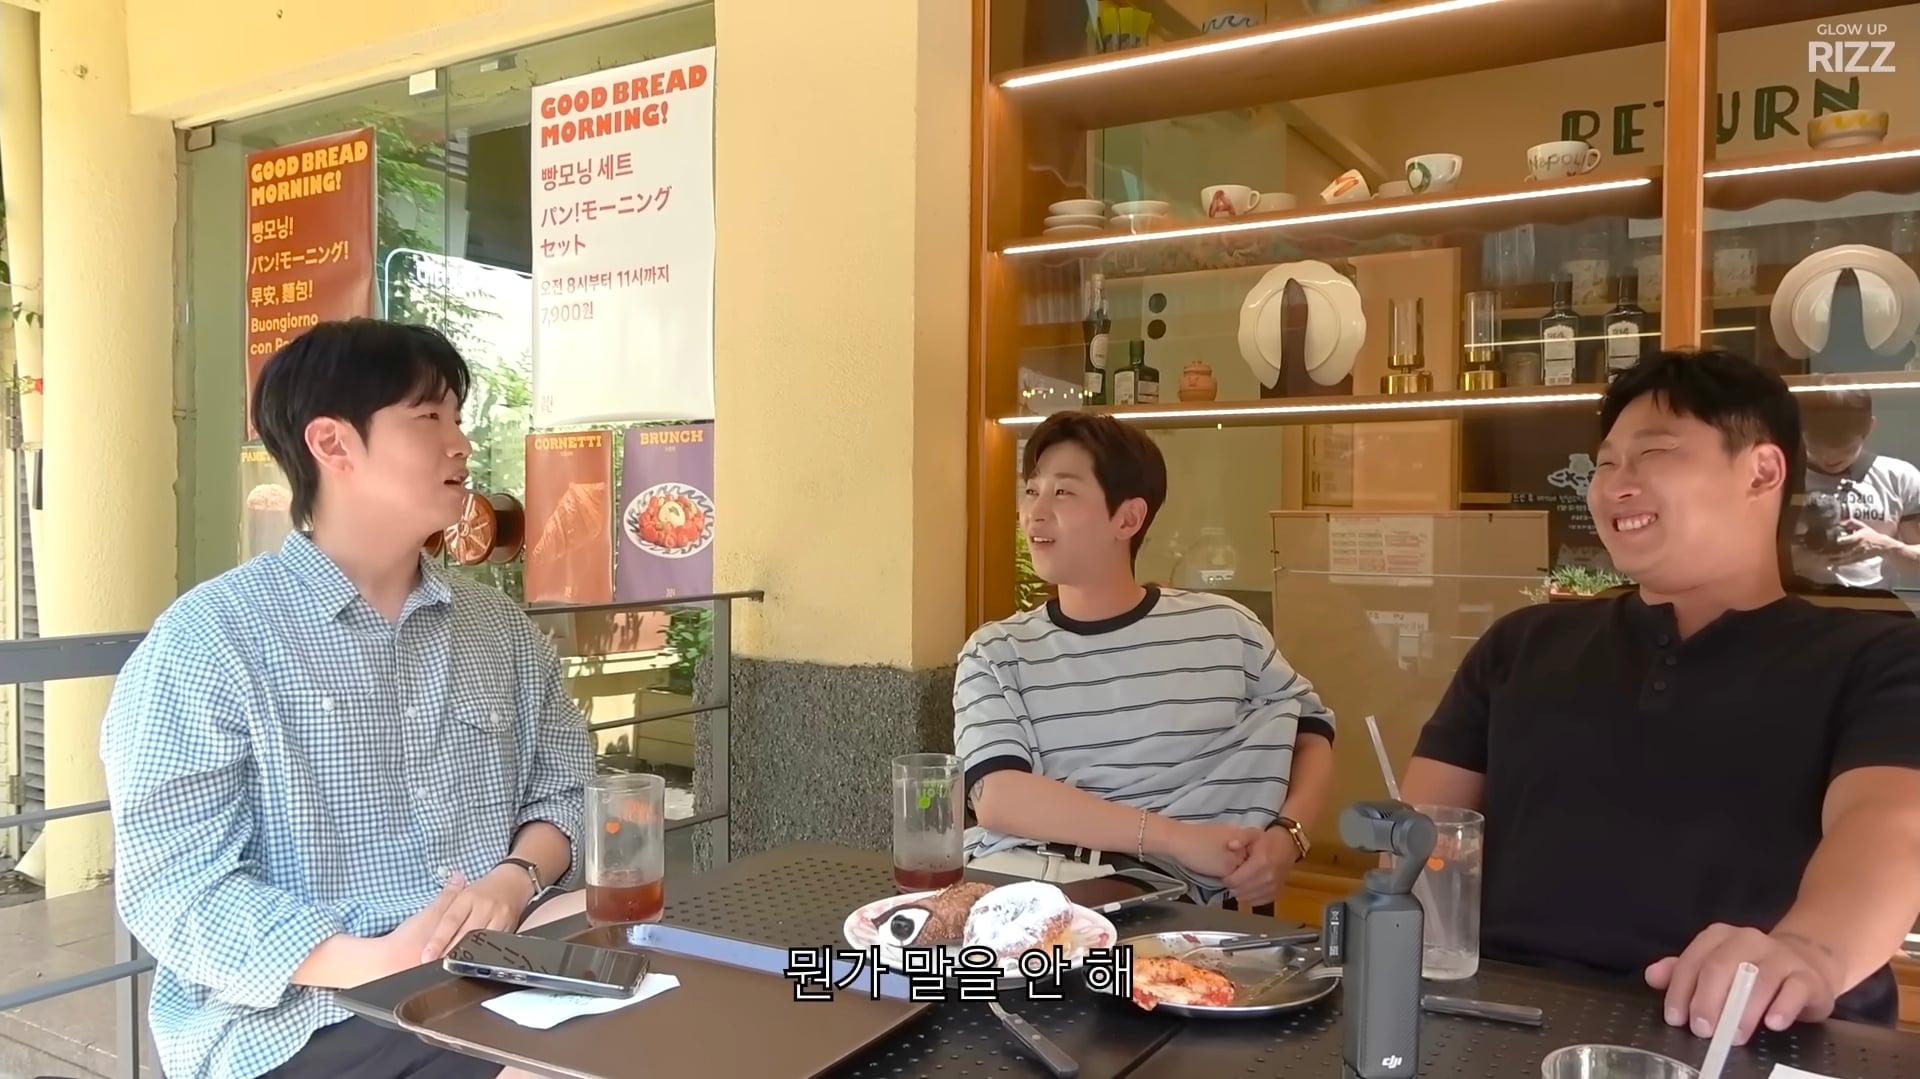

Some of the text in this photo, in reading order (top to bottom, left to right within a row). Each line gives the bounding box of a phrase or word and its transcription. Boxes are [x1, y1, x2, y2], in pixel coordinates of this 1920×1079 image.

[541, 64, 707, 119] GOOD BREAD
[541, 101, 668, 148] MORNING!
[251, 140, 369, 183] GOOD BREAD
[541, 152, 634, 192] 빵모닝 세트
[251, 170, 342, 207] MORNING!
[541, 185, 673, 228] パン!モーニング
[251, 215, 294, 244] 빵모닝!
[251, 241, 349, 275] パン!モーニング!
[540, 233, 587, 258] セット
[541, 264, 670, 296] 오전 8시부터 11시까지
[251, 312, 318, 333] Buongiorno
[541, 301, 594, 326] 7,900원
[250, 339, 272, 356] con
[534, 435, 602, 450] CORNETTI
[640, 430, 703, 445] BRUNCH
[1382, 1055, 1402, 1069] dji
